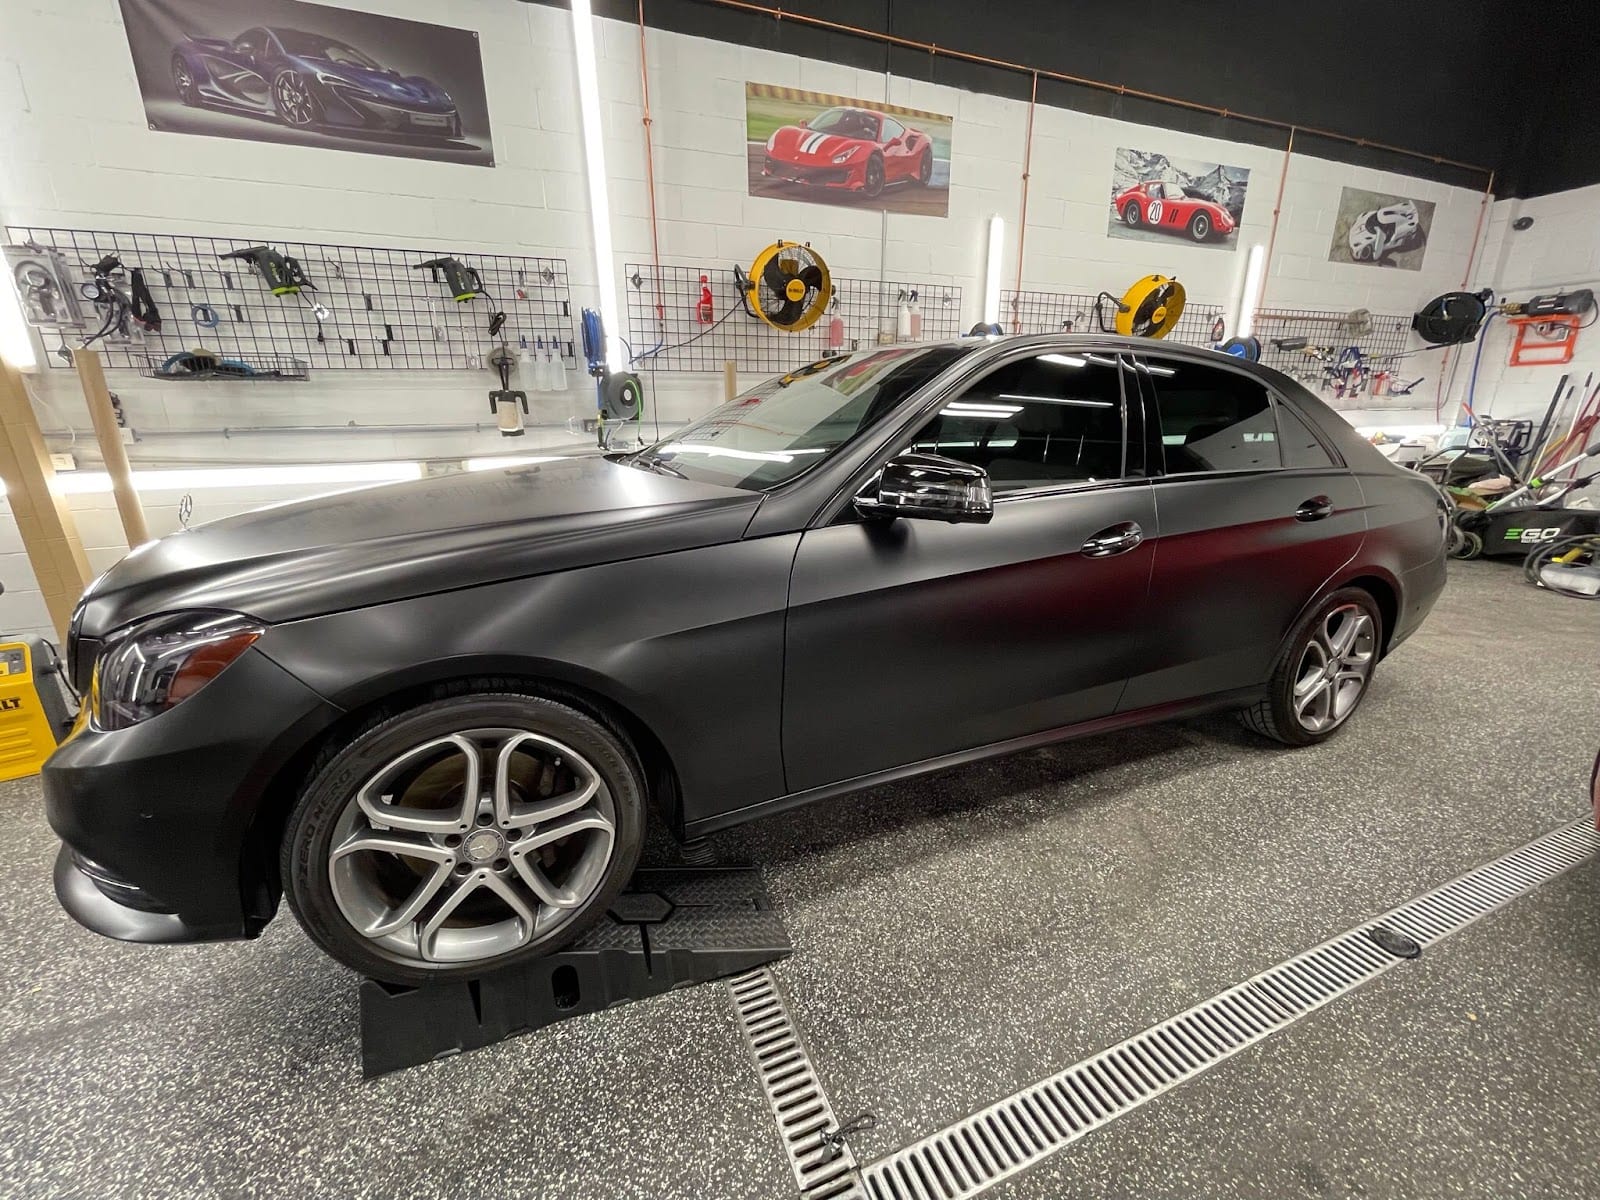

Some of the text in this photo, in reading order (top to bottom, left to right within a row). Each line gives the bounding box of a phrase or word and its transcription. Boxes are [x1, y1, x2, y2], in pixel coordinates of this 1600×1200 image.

[1150, 202, 1161, 222] 20
[1504, 528, 1560, 540] EGO
[0, 697, 21, 711] LT
